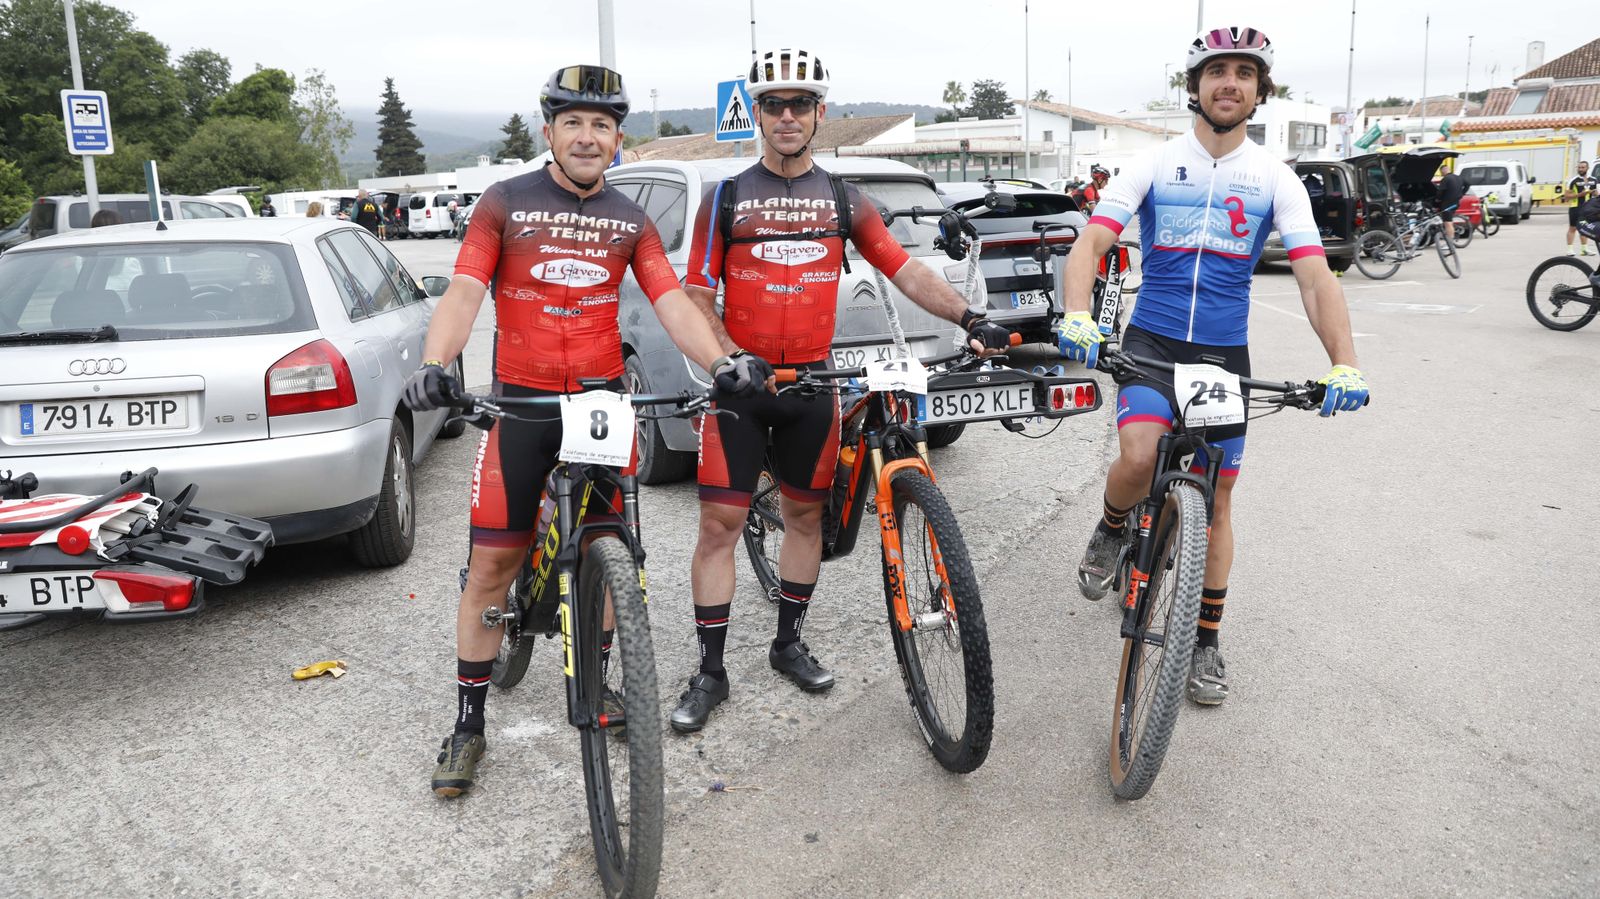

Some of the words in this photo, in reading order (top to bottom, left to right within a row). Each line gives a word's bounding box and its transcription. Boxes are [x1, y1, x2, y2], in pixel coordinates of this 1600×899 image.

[736, 197, 838, 210] ALANMAT
[511, 210, 638, 234] GALANMATIC
[761, 211, 818, 222] TEAM
[1160, 213, 1227, 231] Ciclismo
[549, 226, 600, 243] TEAM
[1159, 229, 1247, 252] Gaditano
[585, 248, 608, 258] PLAY
[777, 244, 825, 256] Gavera
[560, 263, 608, 277] Gavera
[1101, 290, 1118, 325] 8295
[834, 349, 866, 369] 502
[932, 393, 985, 418] 8502
[993, 388, 1030, 413] KLF
[1190, 380, 1228, 406] 24
[43, 403, 114, 431] 7914
[127, 400, 177, 427] BTP
[590, 409, 609, 441] 8
[30, 576, 96, 606] BTP
